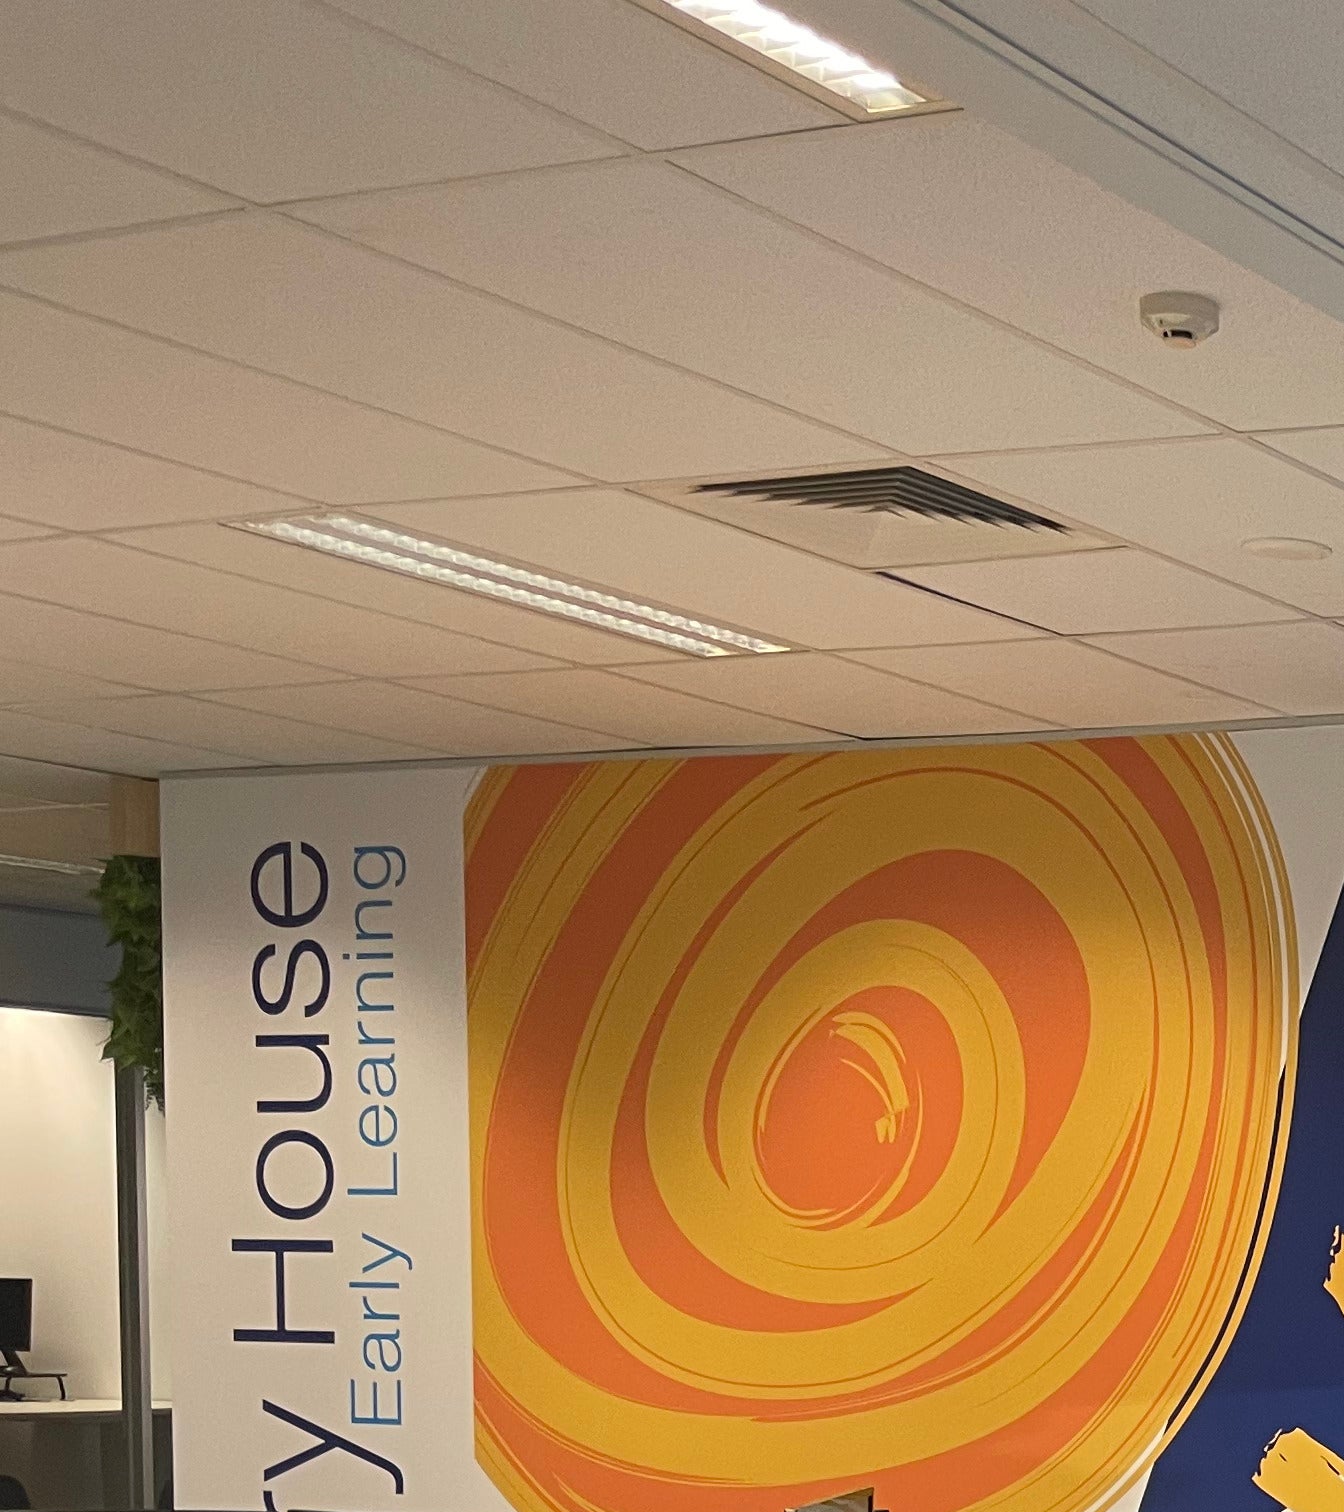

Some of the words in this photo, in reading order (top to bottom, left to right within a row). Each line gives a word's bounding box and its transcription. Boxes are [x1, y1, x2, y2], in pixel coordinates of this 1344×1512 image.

[231, 840, 335, 1345] House
[343, 845, 407, 1196] Learning
[349, 1231, 412, 1426] Early
